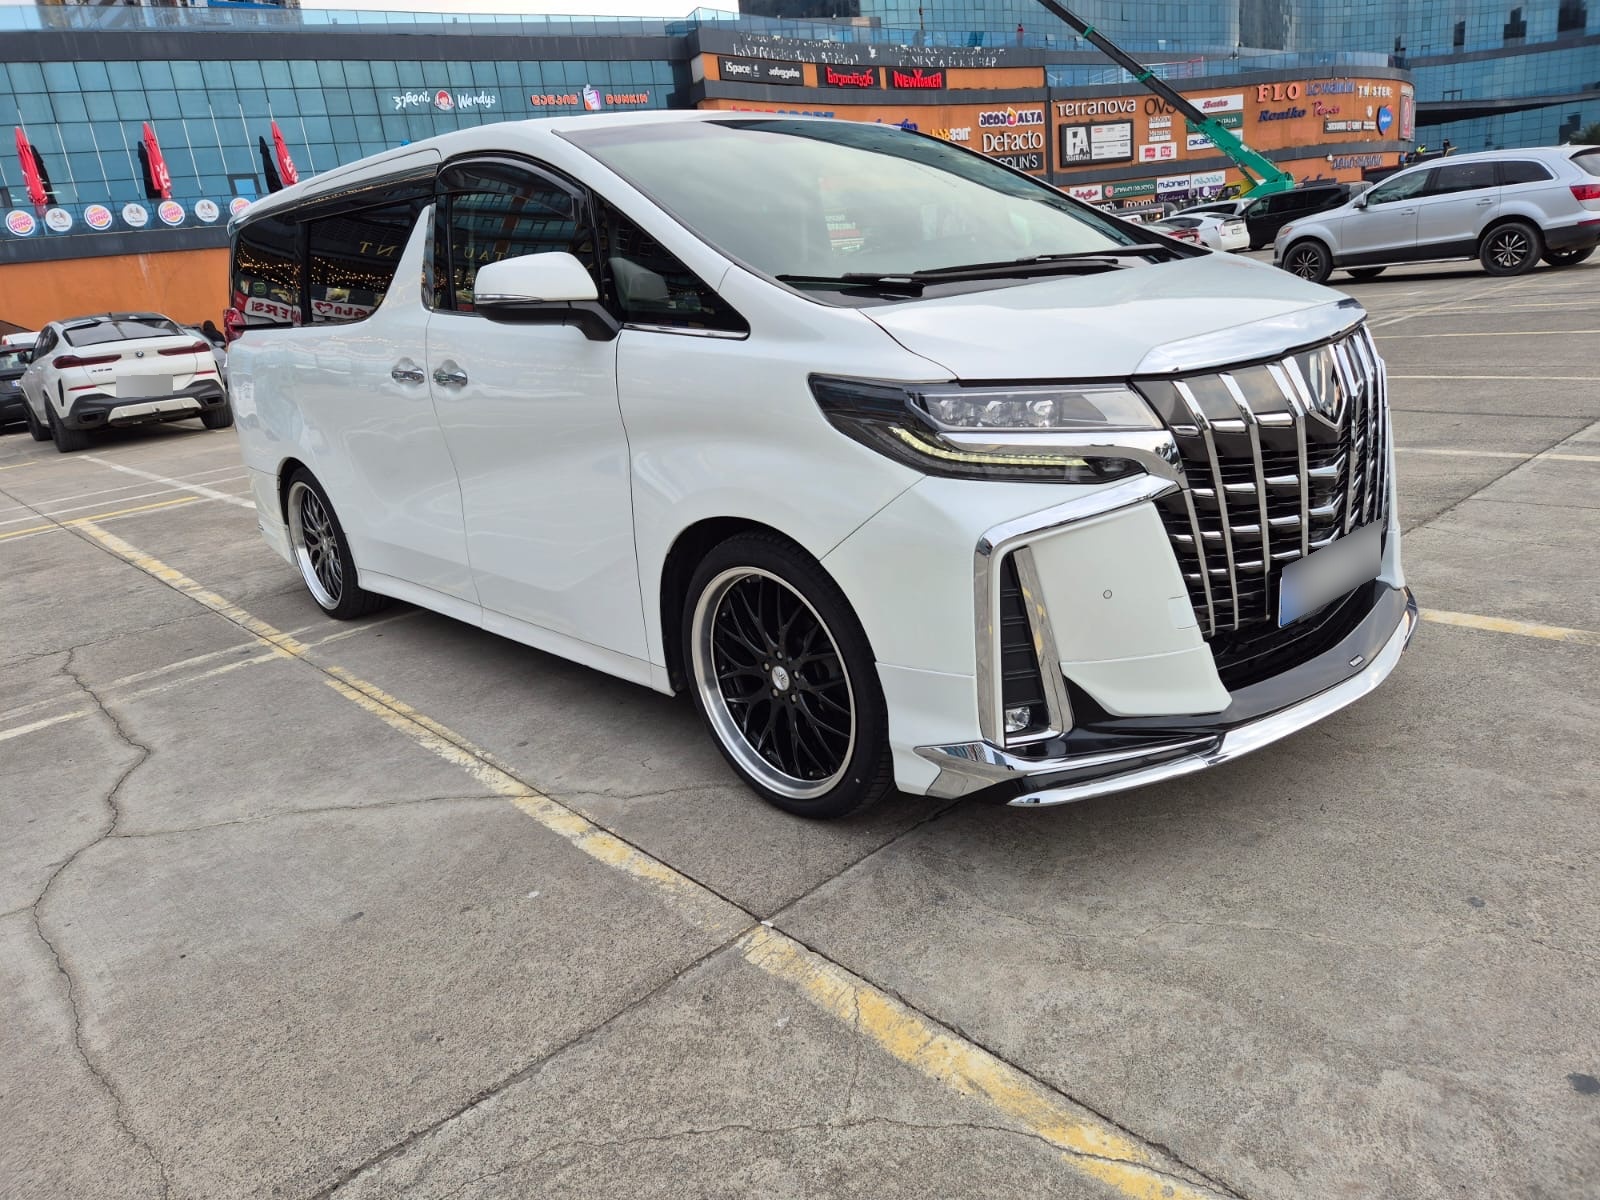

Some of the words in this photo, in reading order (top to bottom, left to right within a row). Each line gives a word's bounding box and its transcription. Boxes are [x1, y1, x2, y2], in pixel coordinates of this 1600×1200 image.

[725, 61, 751, 75] iSpace
[1256, 83, 1301, 103] FLO
[1057, 99, 1137, 118] Terranova
[1144, 97, 1177, 116] OVS
[1017, 111, 1043, 123] ALTA
[982, 130, 1043, 153] DeFacto
